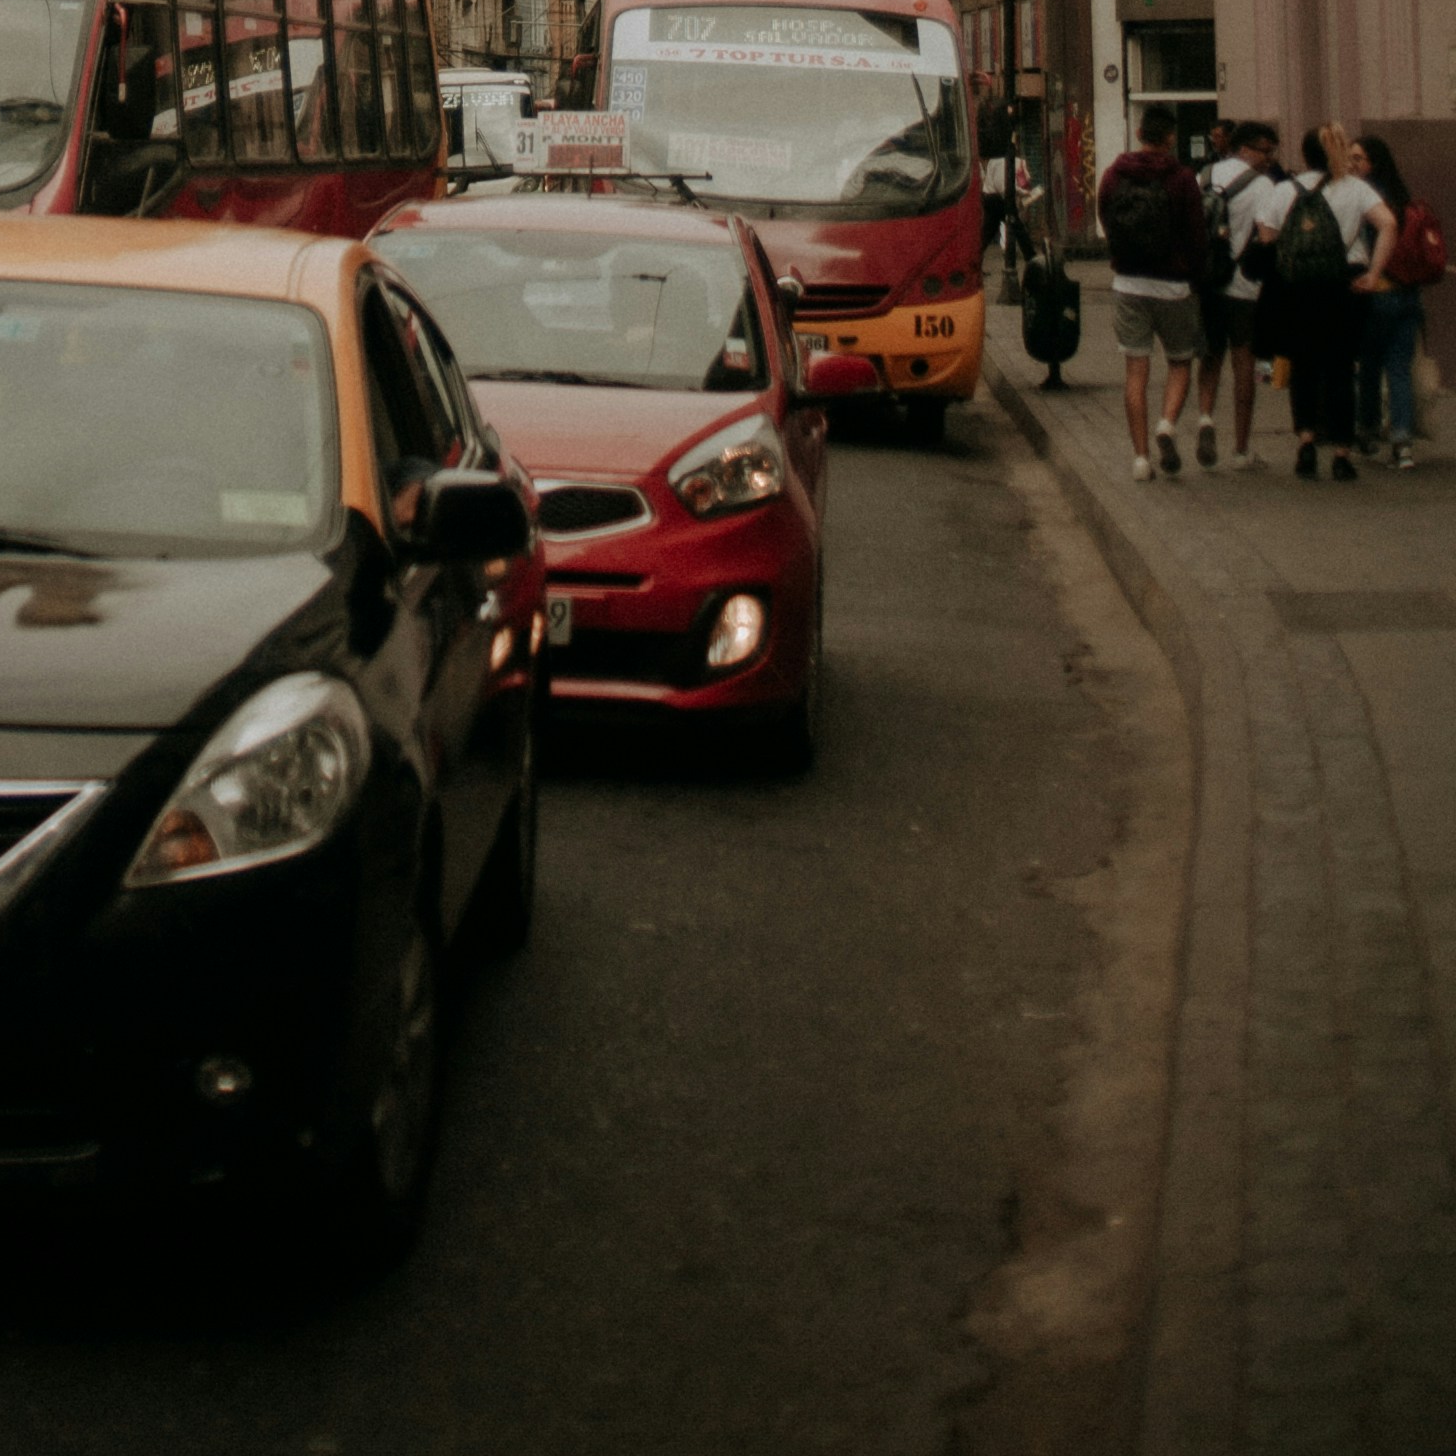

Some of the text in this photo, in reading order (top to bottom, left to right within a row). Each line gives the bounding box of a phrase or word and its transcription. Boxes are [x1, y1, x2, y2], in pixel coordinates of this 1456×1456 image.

[667, 14, 717, 41] 707
[689, 49, 706, 60] 7
[712, 49, 766, 63] TOP
[769, 51, 826, 65] TUR
[543, 114, 580, 126] PLAYA
[583, 114, 625, 127] ANCHA
[516, 131, 534, 154] 31
[562, 136, 624, 144] MONTT
[913, 314, 955, 338] 150
